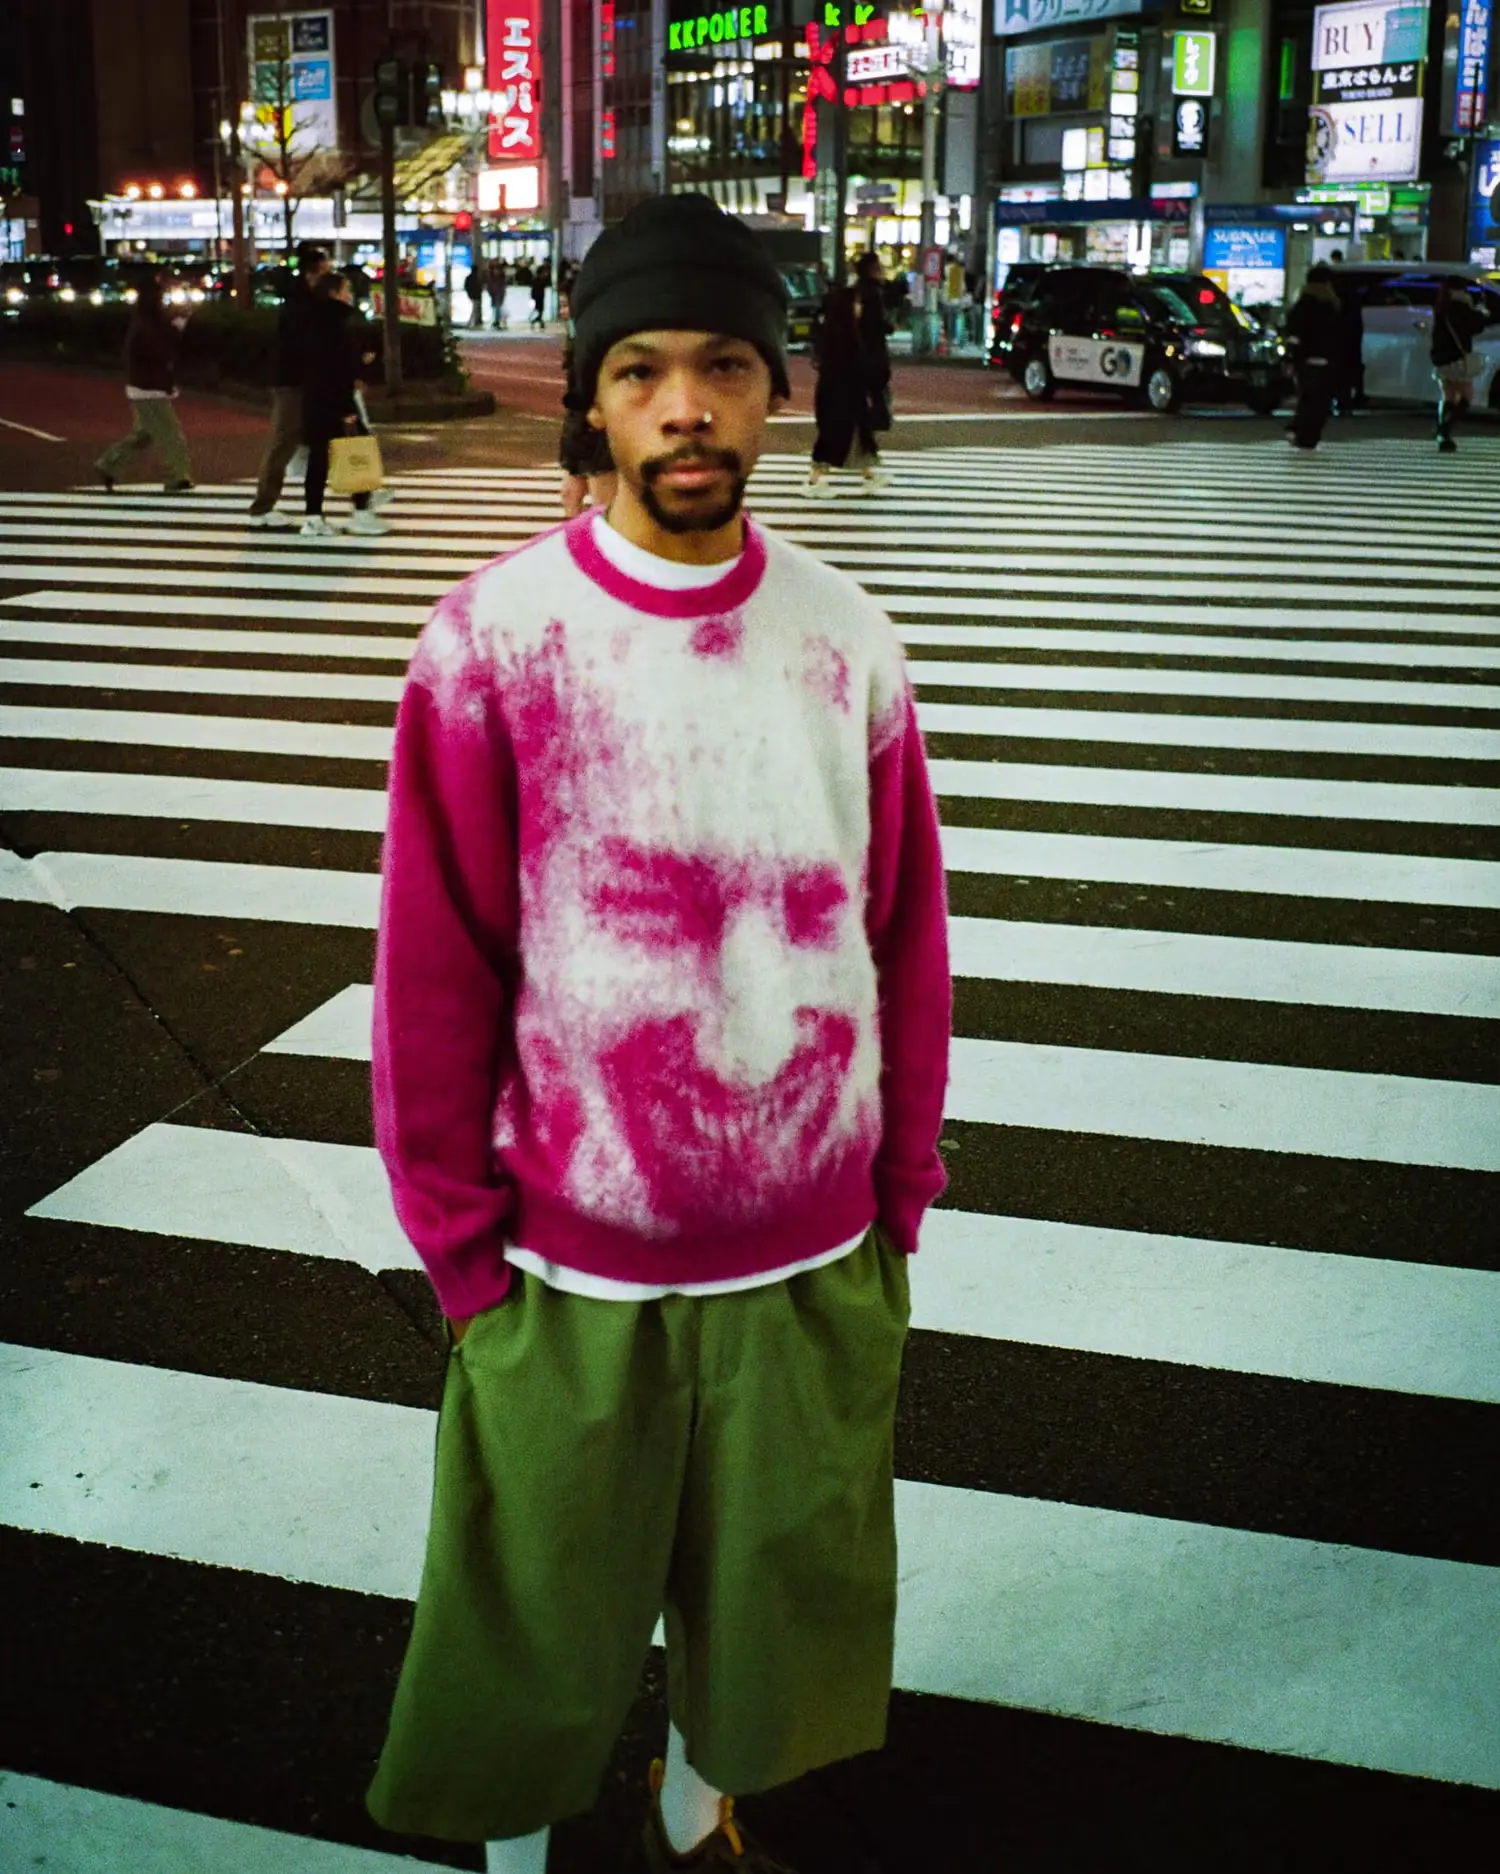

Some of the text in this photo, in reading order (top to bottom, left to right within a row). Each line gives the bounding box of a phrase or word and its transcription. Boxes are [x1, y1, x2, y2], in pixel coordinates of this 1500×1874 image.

[669, 5, 767, 50] KKPOKER
[1325, 21, 1380, 55] BUY
[1340, 112, 1412, 145] SELL
